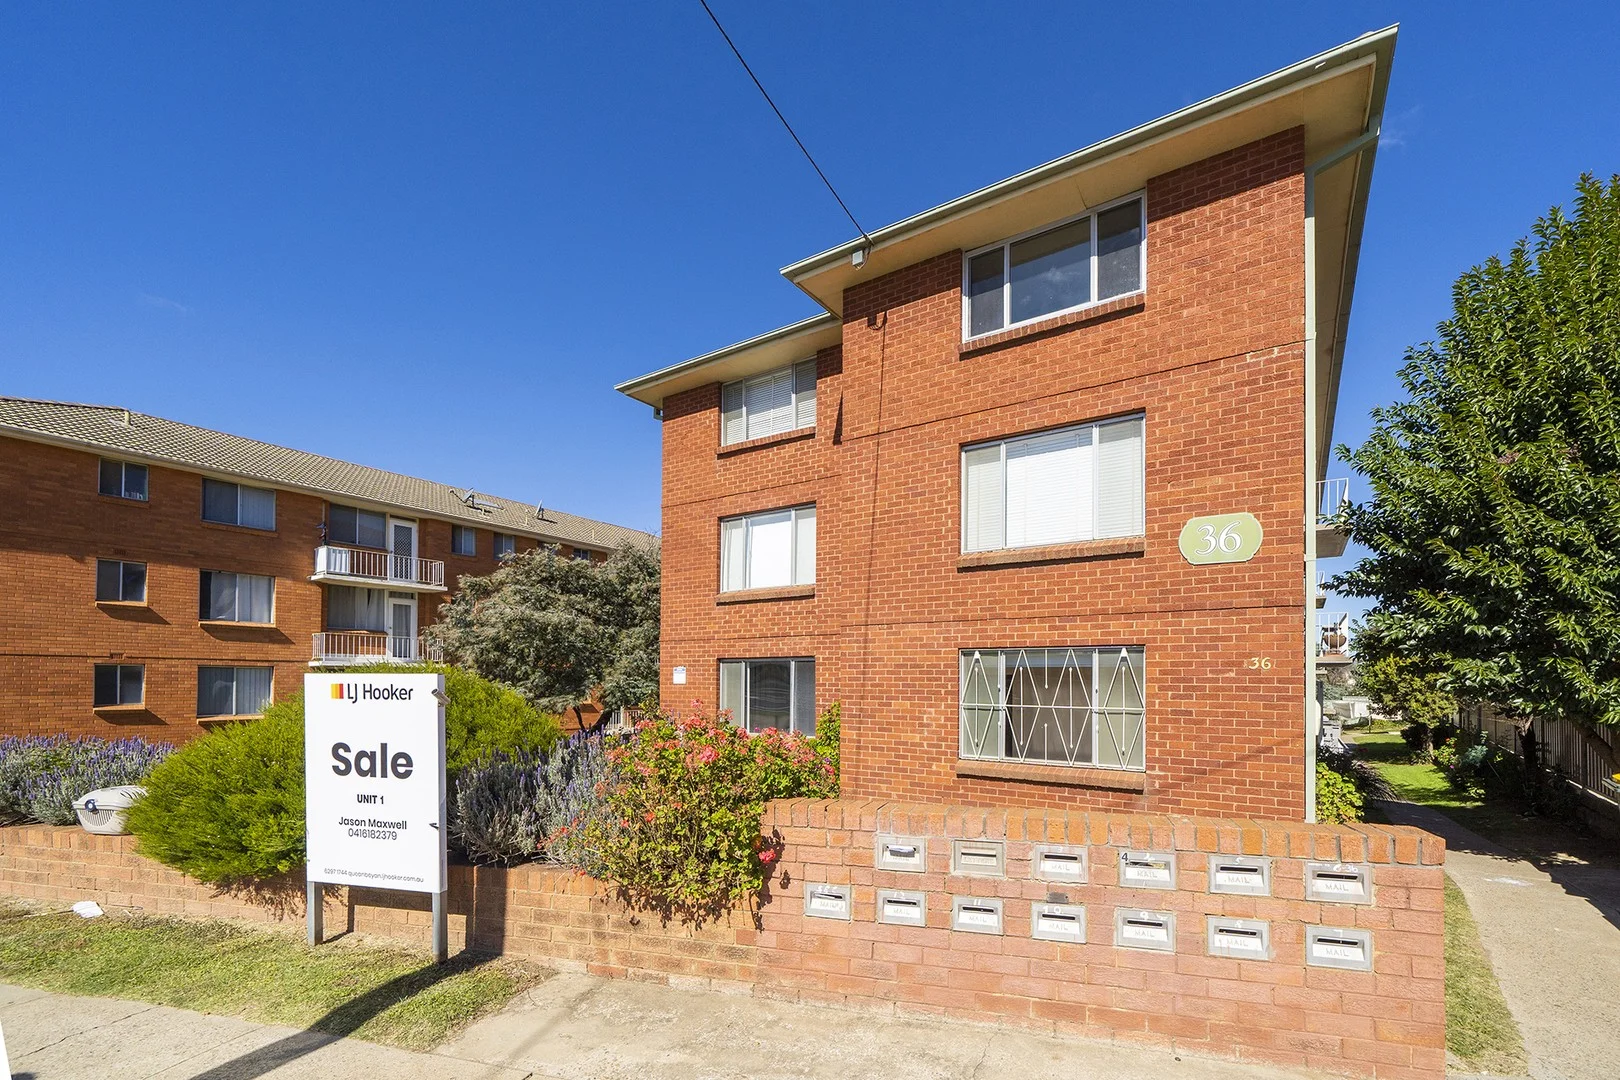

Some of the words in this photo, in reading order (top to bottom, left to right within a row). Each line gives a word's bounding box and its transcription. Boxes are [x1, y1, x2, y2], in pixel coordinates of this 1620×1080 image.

[1194, 520, 1242, 556] 36
[1248, 657, 1272, 670] 36
[347, 683, 358, 704] LJ
[362, 684, 414, 700] Hooker
[331, 742, 414, 780] Sale
[356, 794, 378, 804] UNIT
[380, 795, 384, 805] 1
[338, 816, 367, 828] Jason
[368, 818, 408, 830] Maxwell
[348, 828, 398, 841] 0416182379
[1121, 852, 1129, 862] 4
[1052, 862, 1070, 870] MAIL
[1136, 870, 1158, 878] MAIL
[1228, 876, 1250, 884] MAIL
[1324, 883, 1350, 892] MAIL
[893, 907, 910, 915] MAIL
[1049, 923, 1069, 931] MAIL
[1134, 930, 1156, 938] MAIL
[1226, 938, 1248, 947] MAIL
[1326, 948, 1350, 958] MAIL
